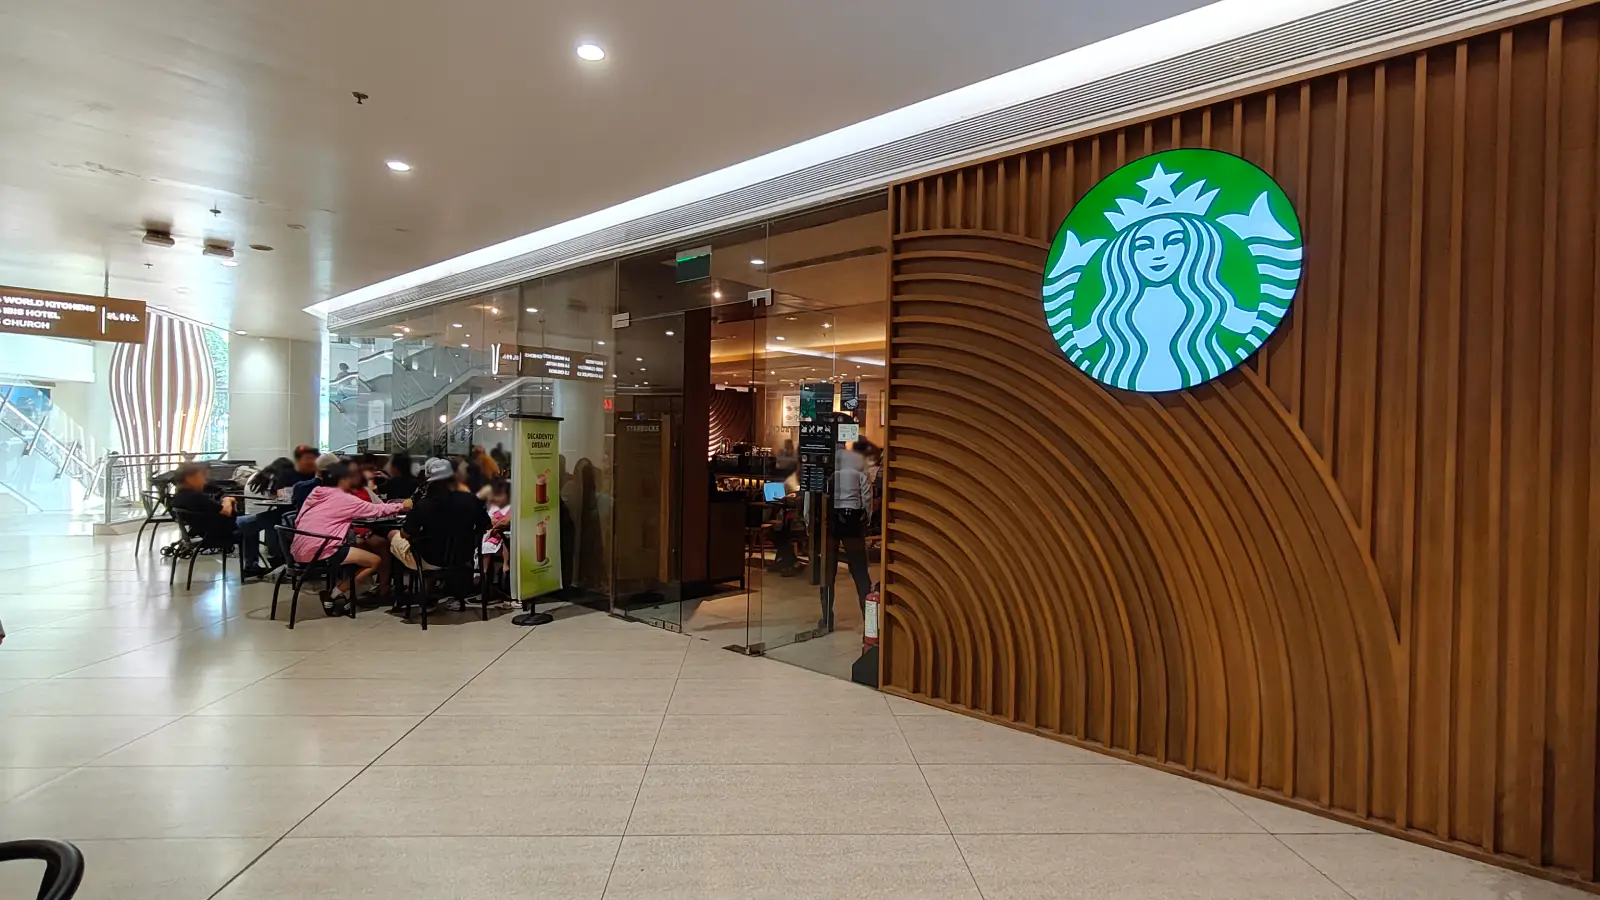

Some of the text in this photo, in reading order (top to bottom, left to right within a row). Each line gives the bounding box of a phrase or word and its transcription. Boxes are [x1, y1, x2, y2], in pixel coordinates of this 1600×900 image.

[3, 296, 44, 306] WORLD
[45, 301, 96, 312] KITCHENS
[25, 309, 60, 319] HOTEL
[3, 318, 50, 329] CHURCH
[527, 432, 554, 440] DECADENTLY
[531, 441, 551, 449] DREAMY
